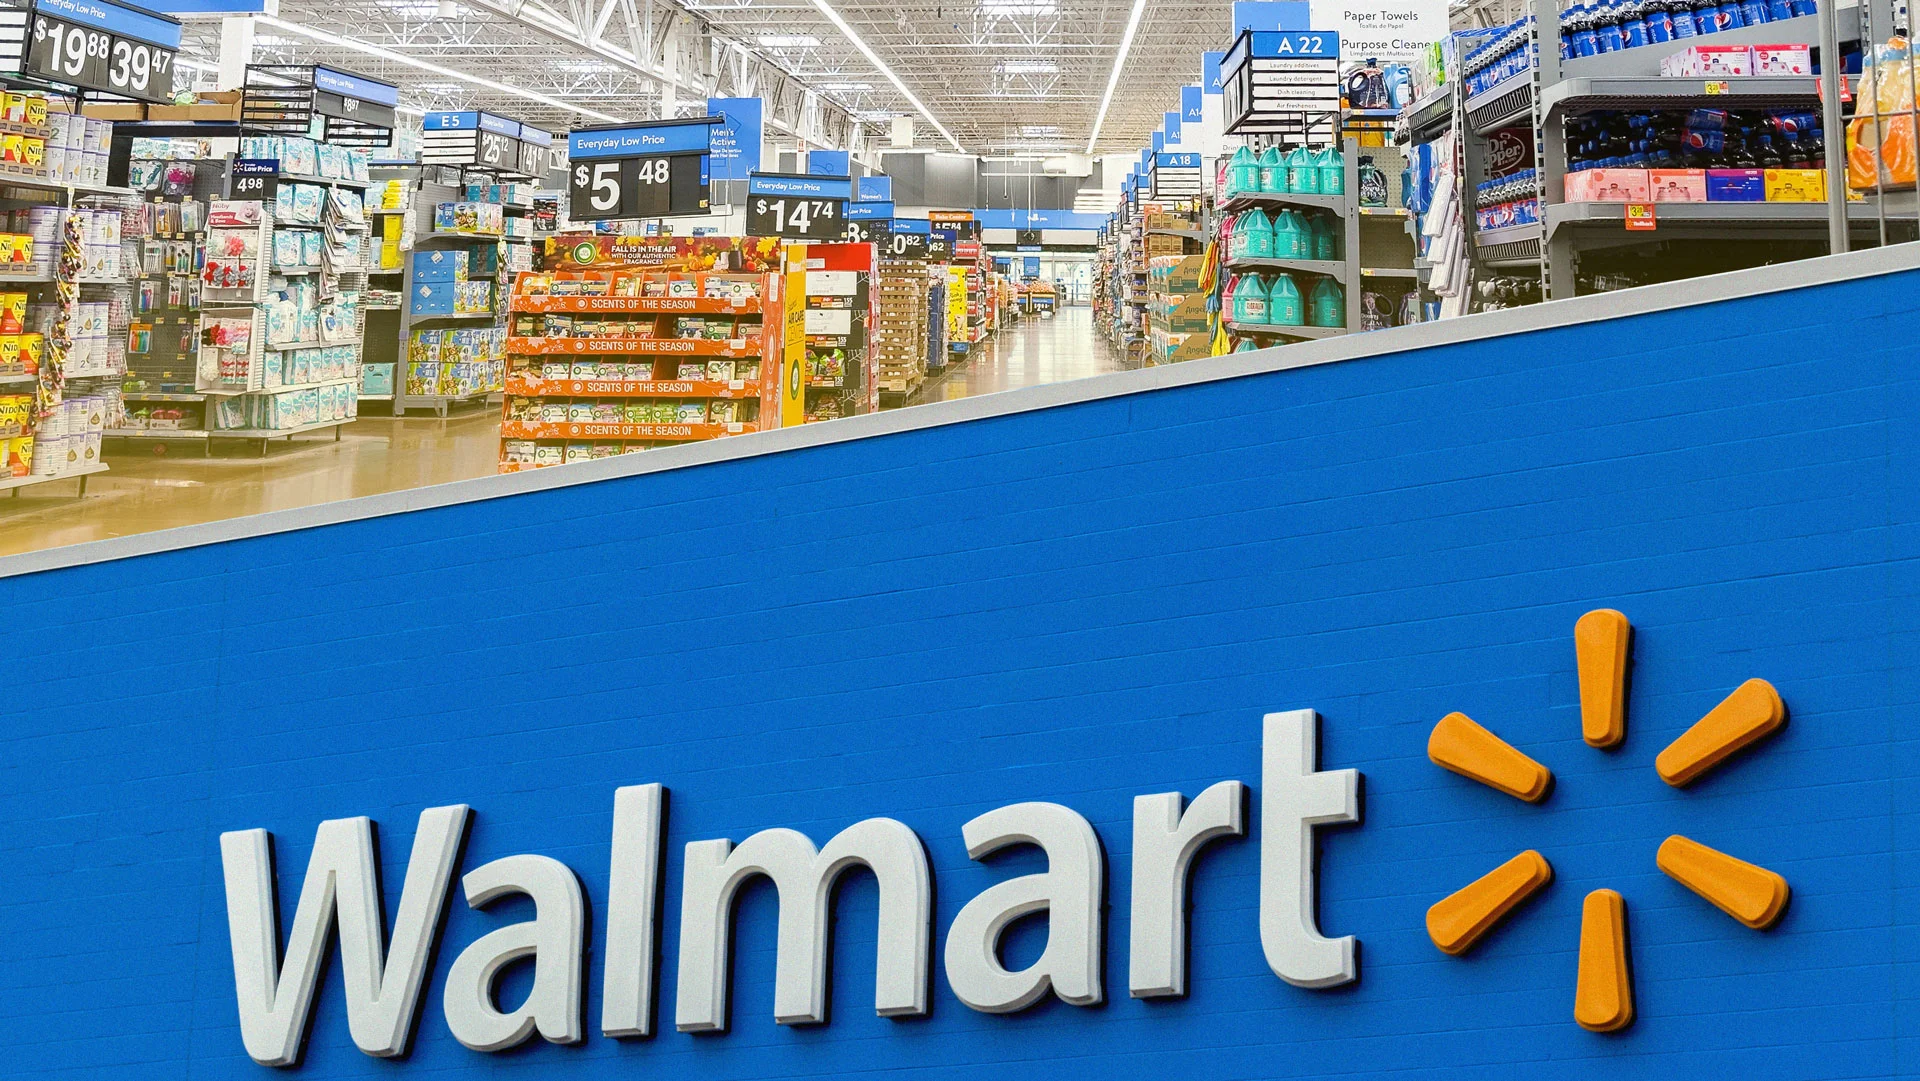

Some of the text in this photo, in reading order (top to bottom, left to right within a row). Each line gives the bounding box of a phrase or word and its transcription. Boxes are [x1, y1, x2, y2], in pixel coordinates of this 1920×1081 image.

[45, 0, 106, 19] veryday Low Price
[1344, 10, 1419, 23] Paper Towels
[1277, 36, 1323, 54] A 22
[1341, 39, 1431, 51] Purpose Cleane
[29, 105, 46, 115] NID
[441, 115, 460, 127] E 5
[710, 127, 735, 137] Men's
[1170, 131, 1180, 139] A1
[577, 134, 666, 149] Everyday Low Price
[710, 137, 737, 146] Active
[1169, 155, 1191, 165] A 18
[756, 181, 821, 191] Everyday Low Price
[611, 245, 677, 253] FALL IS IN THE AIR
[591, 299, 696, 309] SCENTS OF THE SEASON
[589, 341, 695, 351] SCENTS OF THE SEASON
[587, 382, 693, 393] SCENTS OF THE SEASON
[585, 425, 692, 435] SCENTS OF THE SEASON
[220, 708, 1362, 1068] Walmart
